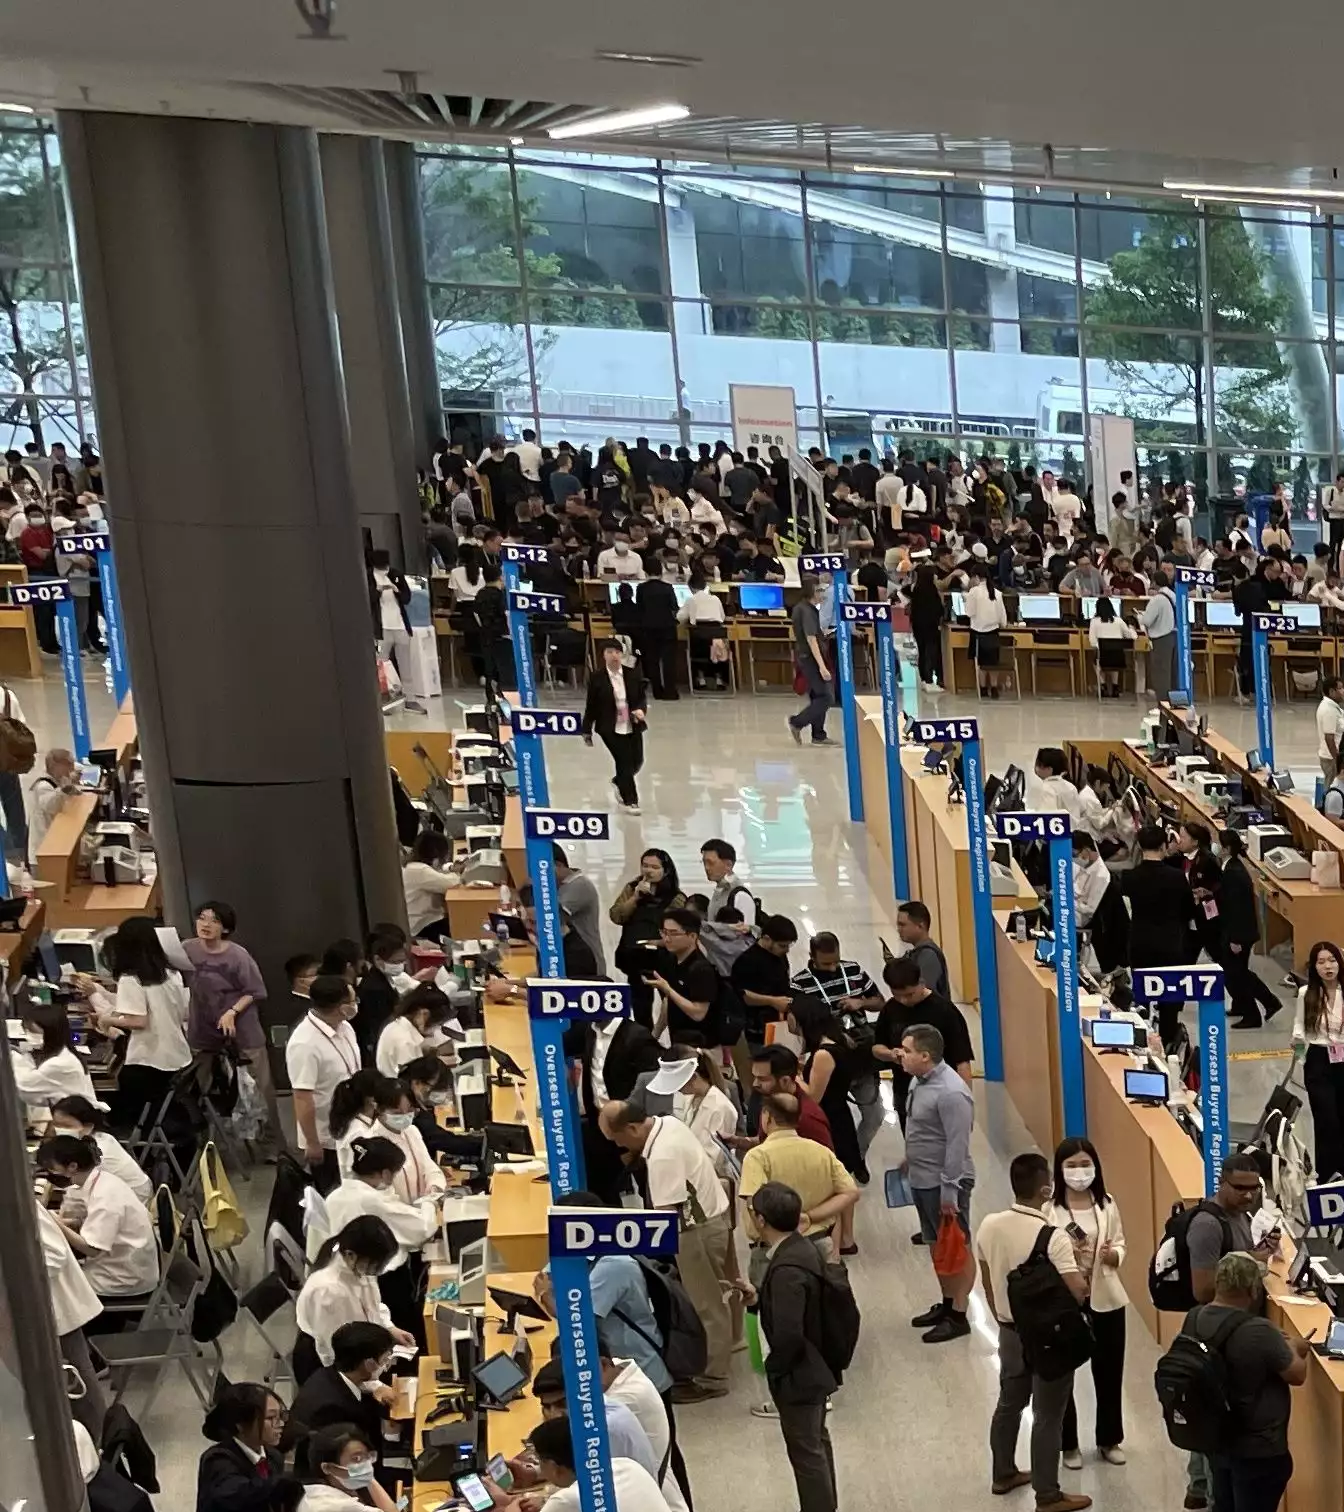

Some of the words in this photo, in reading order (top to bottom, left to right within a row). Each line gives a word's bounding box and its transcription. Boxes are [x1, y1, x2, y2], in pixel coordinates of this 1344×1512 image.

[62, 538, 105, 552] D-01
[508, 548, 547, 562] D-12
[804, 558, 841, 570] D-13
[1181, 571, 1214, 584] D-24
[16, 586, 64, 602] D-02
[517, 596, 560, 612] D-11
[845, 606, 888, 619] D-14
[1259, 617, 1296, 630] D-23
[520, 715, 577, 732] D-10
[920, 723, 972, 739] D-15
[536, 816, 602, 835] D-09
[1004, 818, 1064, 835] D-16
[539, 860, 552, 911] Overseas
[1057, 859, 1068, 907] Overseas
[1060, 949, 1073, 1012] Registration
[1144, 976, 1216, 996] D-17
[542, 990, 623, 1013] D-08
[1208, 1025, 1220, 1080] Overseas
[545, 1044, 562, 1106] Overseas
[1208, 1085, 1222, 1130] Buyers'
[566, 1220, 669, 1248] D-07
[568, 1289, 588, 1367] Overseas
[578, 1370, 598, 1432] Buyers'
